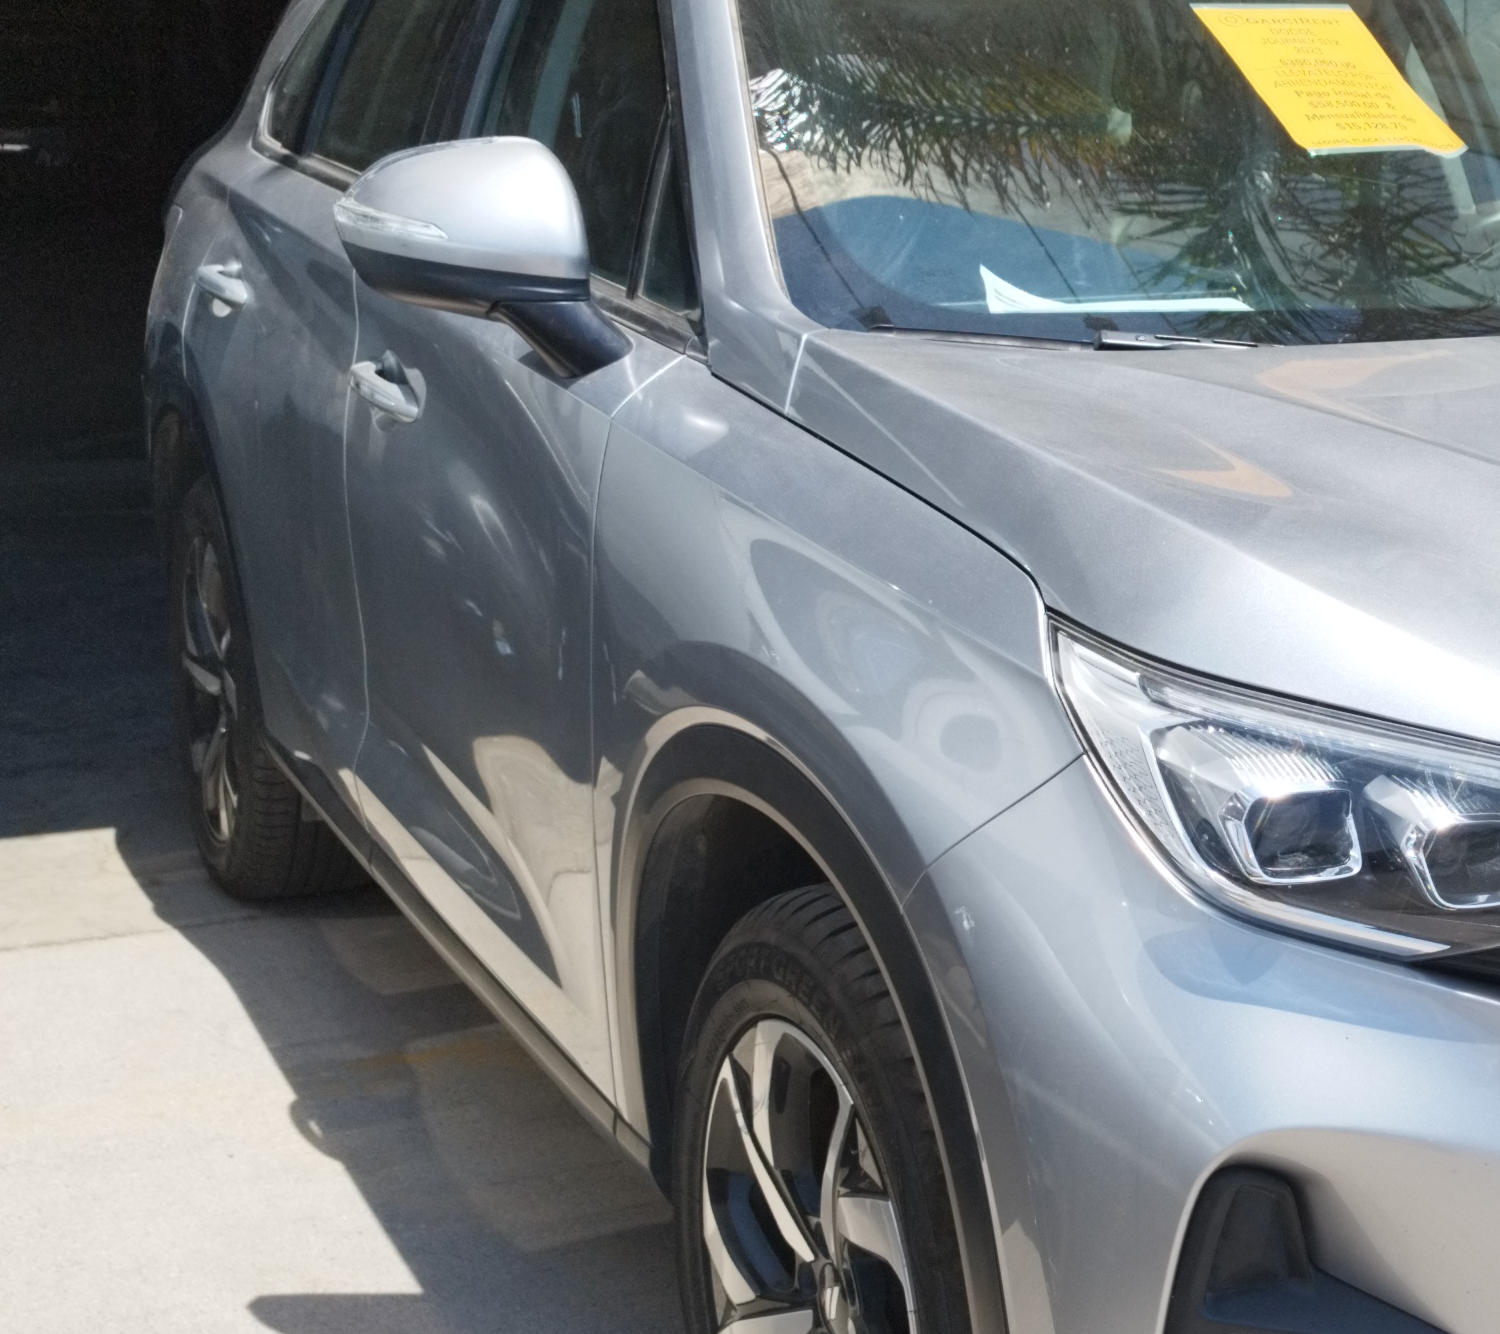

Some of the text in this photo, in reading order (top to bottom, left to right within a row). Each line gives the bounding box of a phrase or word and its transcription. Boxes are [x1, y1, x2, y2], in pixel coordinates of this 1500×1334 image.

[1269, 28, 1317, 37] DODGE
[1261, 37, 1315, 45] JOURNEY
[1294, 89, 1330, 99] Pago
[1375, 92, 1392, 101] de
